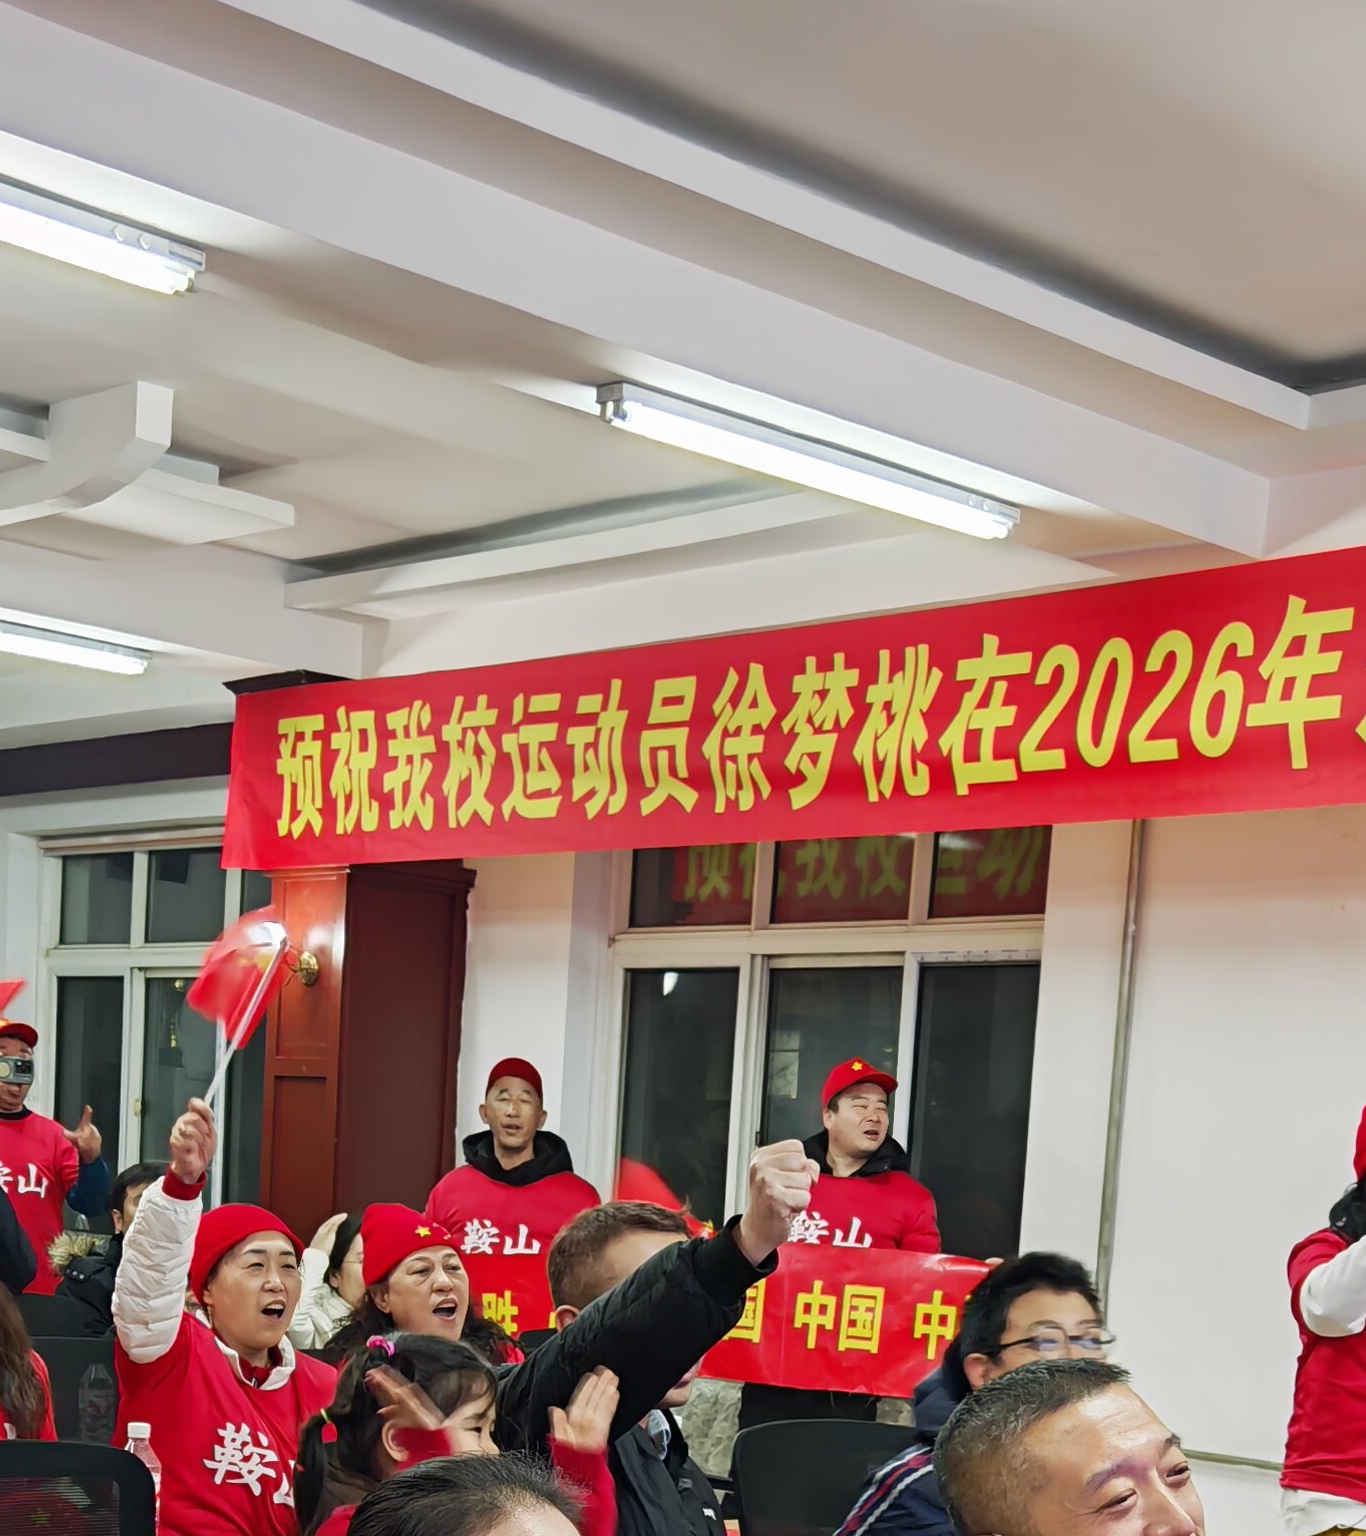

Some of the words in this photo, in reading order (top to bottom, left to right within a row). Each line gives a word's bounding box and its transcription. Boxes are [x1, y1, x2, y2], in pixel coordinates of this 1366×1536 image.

[460, 1218, 541, 1255] 鞍山
[793, 1280, 885, 1354] 中国
[913, 1290, 972, 1360] 中
